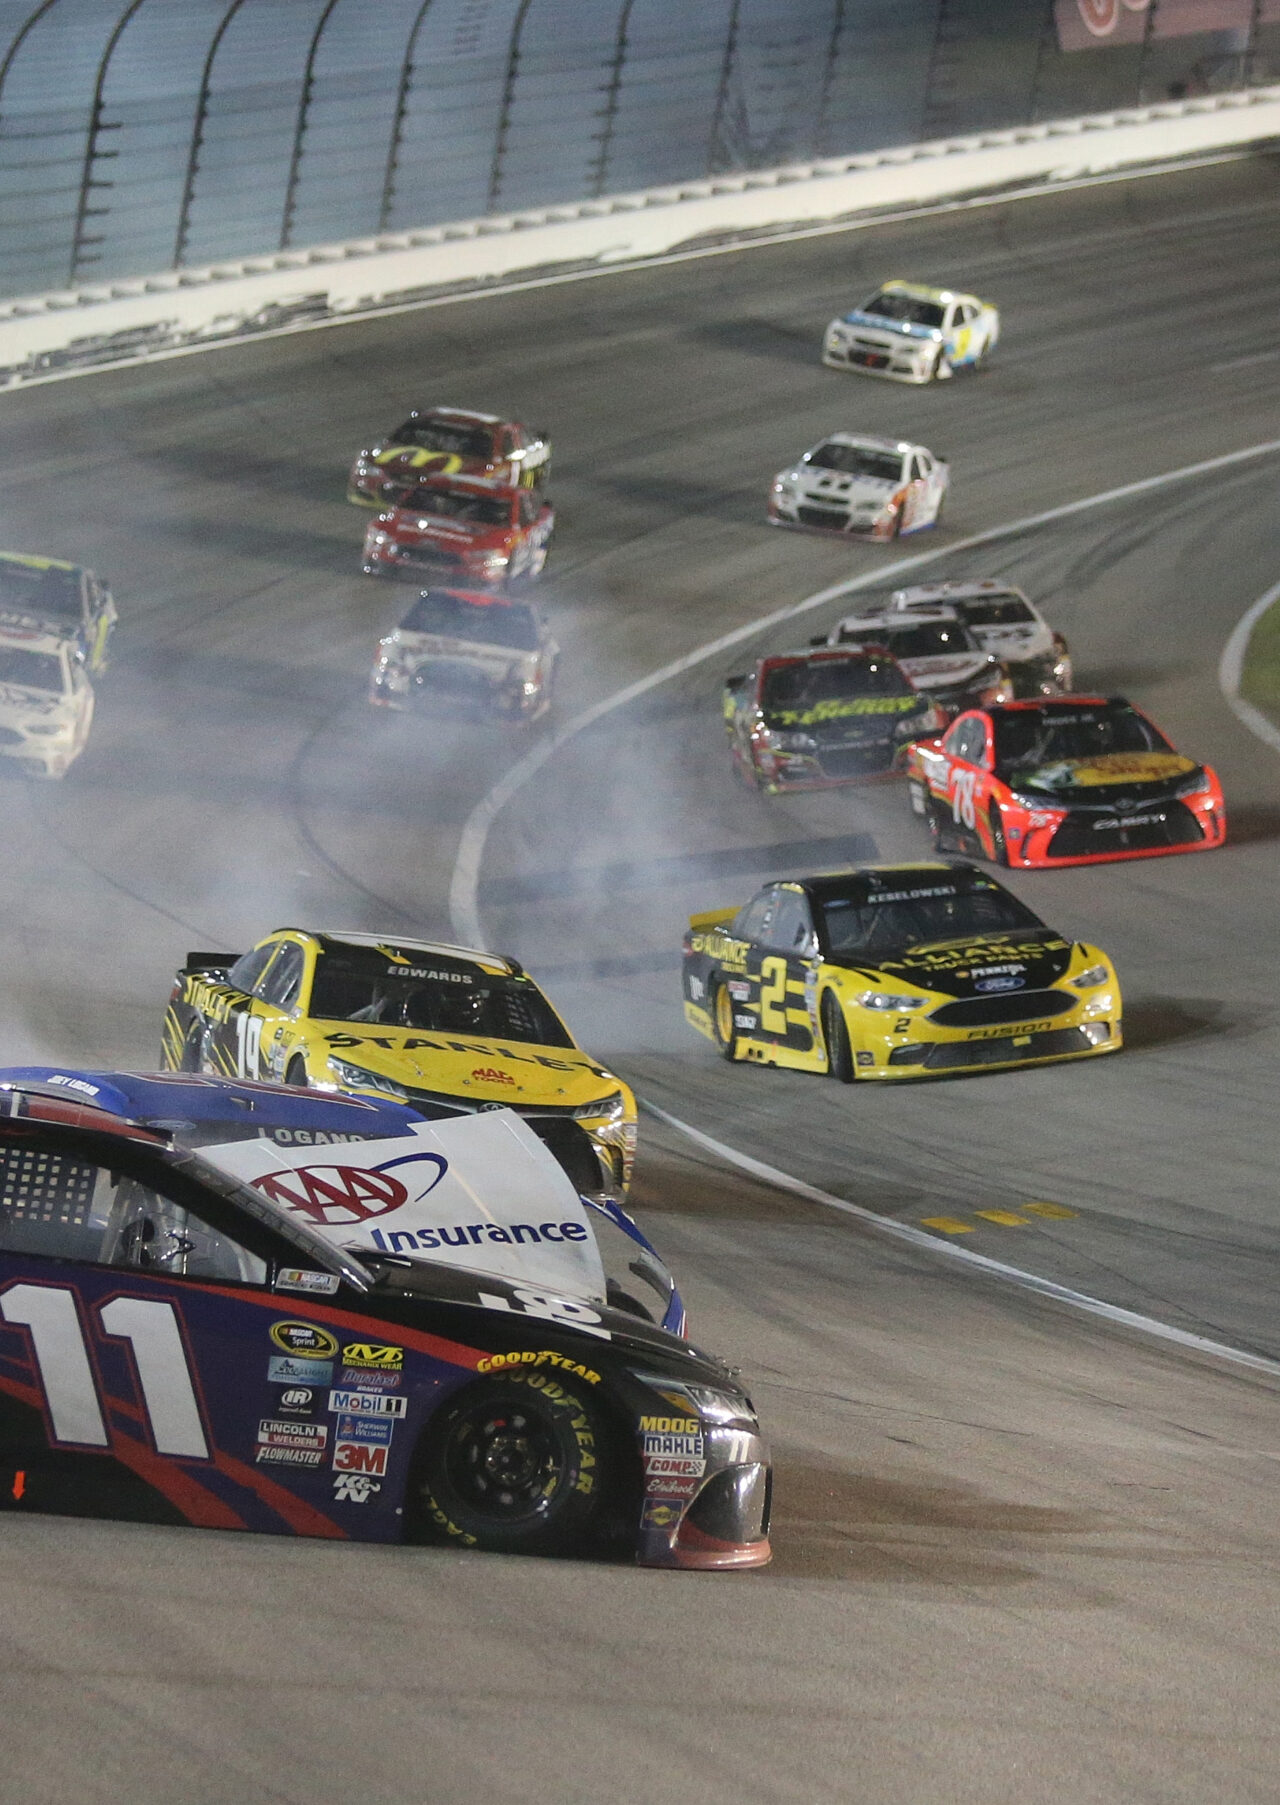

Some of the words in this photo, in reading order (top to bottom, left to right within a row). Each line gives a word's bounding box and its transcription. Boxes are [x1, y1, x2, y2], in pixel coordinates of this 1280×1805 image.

[867, 885, 956, 903] KESELOWSKI
[879, 940, 1070, 971] ALLIANCE
[387, 965, 473, 984] EDWARDS
[762, 956, 787, 1034] 2
[893, 1017, 912, 1034] 2
[967, 1021, 1052, 1040] FUSION
[237, 1011, 265, 1081] 19
[324, 1032, 612, 1079] STANLEY
[472, 1067, 513, 1081] MAC
[370, 1221, 587, 1253] Insurance
[292, 1337, 315, 1347] Sprint
[0, 1284, 209, 1459] 11
[380, 1362, 402, 1370] WEAR
[477, 1350, 602, 1385] GOODYEAR
[334, 1392, 381, 1411] Mobil
[263, 1422, 315, 1436] LINCOLN
[639, 1416, 699, 1433] MOOG
[273, 1434, 318, 1447] WELDERS
[646, 1437, 702, 1455] MAHLE
[256, 1447, 322, 1464] FLOWMASTER
[335, 1443, 386, 1475] 3M
[651, 1459, 692, 1473] COMP
